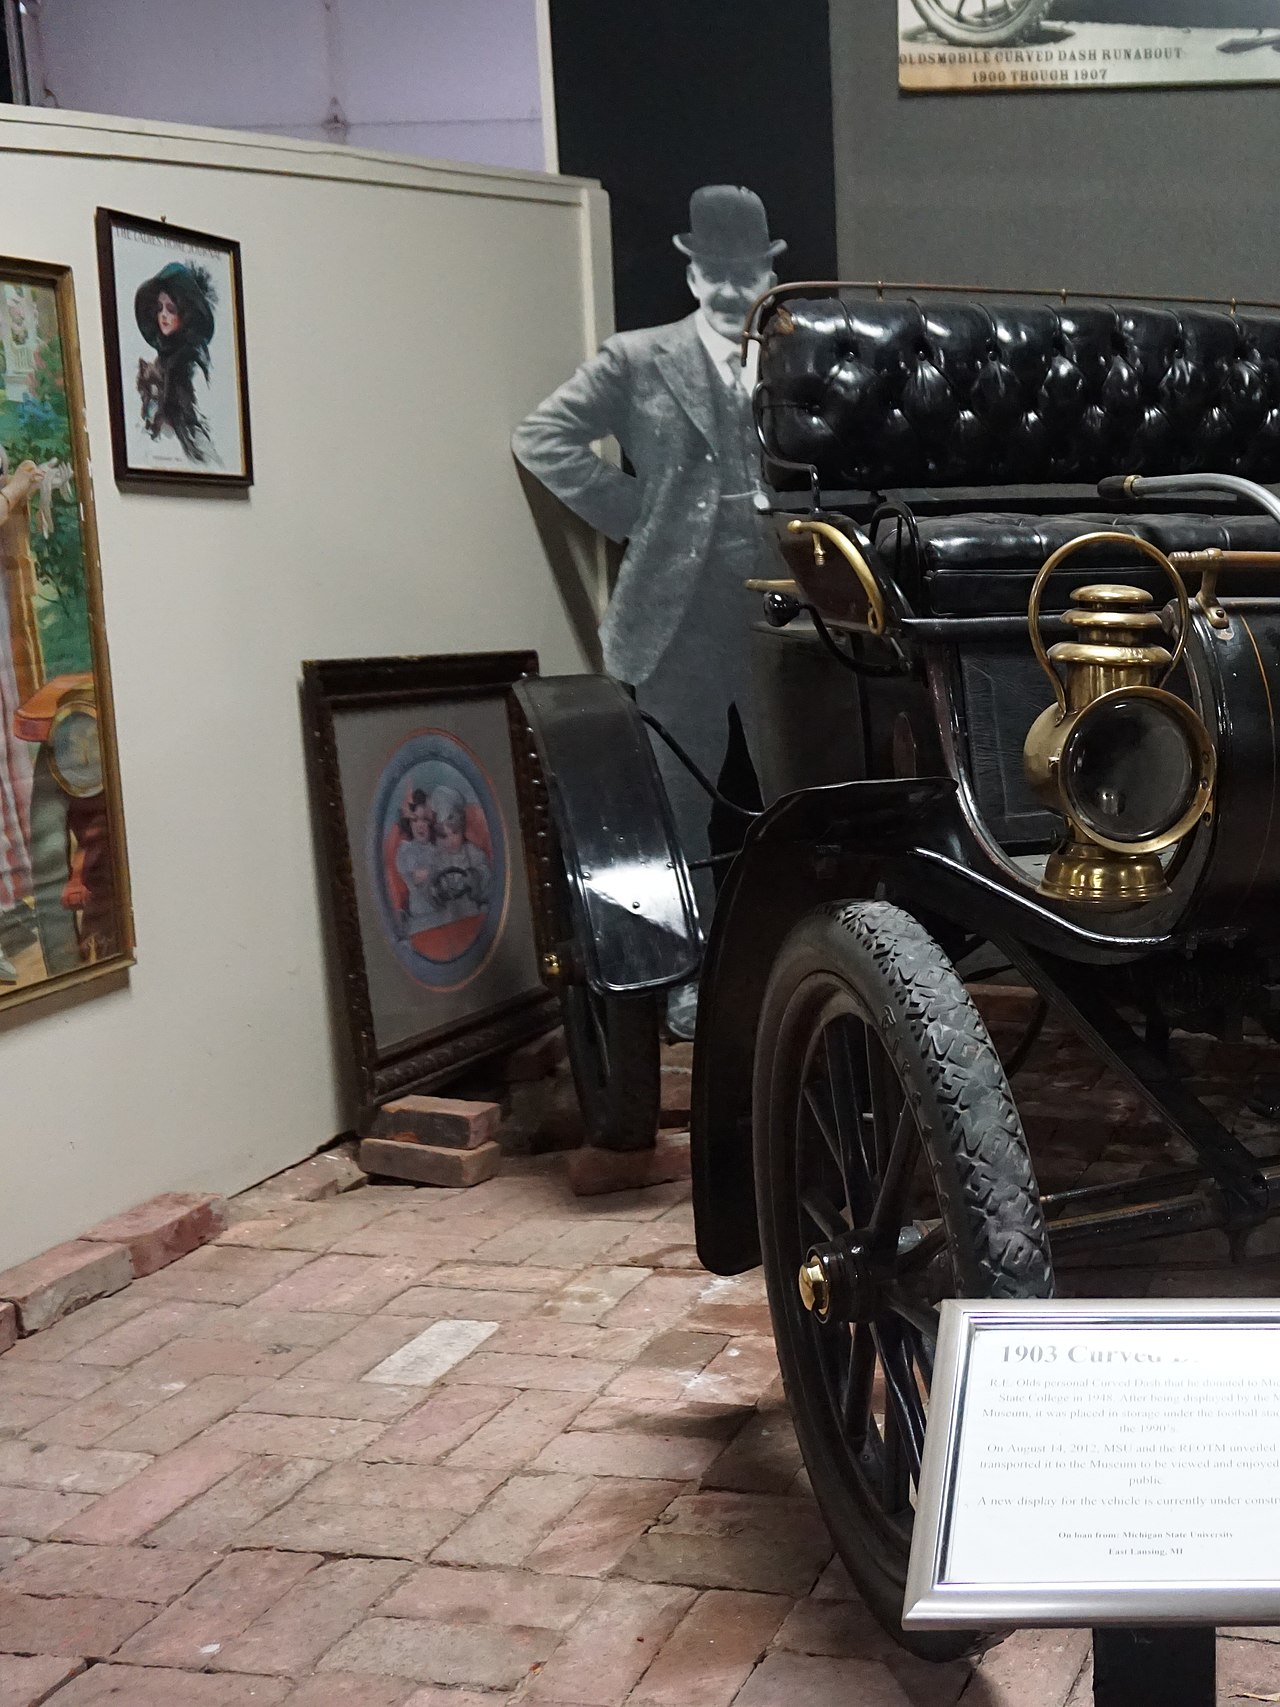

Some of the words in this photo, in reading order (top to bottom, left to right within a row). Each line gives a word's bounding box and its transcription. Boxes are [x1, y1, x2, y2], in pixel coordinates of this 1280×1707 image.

[899, 51, 991, 65] OLDSMOBILE
[994, 49, 1054, 63] CURVED
[1058, 49, 1097, 61] DASH
[1101, 47, 1183, 60] RUNABOUT
[972, 71, 1007, 82] 1900
[1010, 69, 1069, 82] THOUGH
[1074, 69, 1107, 81] 1907
[1001, 1344, 1058, 1364] 1903
[1016, 1378, 1040, 1387] Olds
[1044, 1378, 1089, 1389] personal
[1092, 1378, 1130, 1387] Curved
[1134, 1378, 1161, 1387] Dash
[1164, 1378, 1184, 1387] that
[1187, 1378, 1199, 1387] he
[1202, 1378, 1244, 1387] donated
[1247, 1379, 1258, 1387] to
[999, 1393, 1025, 1403] State
[1028, 1393, 1069, 1405] College
[1073, 1393, 1083, 1403] in
[1120, 1393, 1147, 1403] After
[1150, 1393, 1180, 1404] being
[1183, 1393, 1233, 1405] displayed
[1237, 1393, 1250, 1405] by
[1253, 1393, 1268, 1402] the
[1035, 1409, 1043, 1418] it
[1046, 1410, 1067, 1418] was
[1070, 1408, 1105, 1419] placed
[1108, 1409, 1119, 1418] in
[1121, 1409, 1160, 1419] storage
[1163, 1408, 1193, 1418] under
[1197, 1408, 1213, 1418] the
[1217, 1408, 1258, 1418] football
[1119, 1424, 1136, 1433] the
[986, 1443, 1004, 1453] On
[1007, 1443, 1046, 1456] August
[1103, 1443, 1133, 1453] MSU
[1136, 1443, 1156, 1453] and
[1159, 1443, 1175, 1453] the
[1229, 1443, 1276, 1453] unveiled
[980, 1460, 1041, 1471] transported
[1044, 1460, 1052, 1469] it
[1055, 1461, 1066, 1469] to
[1069, 1459, 1086, 1469] the
[1089, 1459, 1137, 1469] Museum
[1140, 1460, 1151, 1469] to
[1154, 1459, 1167, 1469] be
[1171, 1459, 1210, 1469] viewed
[1213, 1459, 1233, 1468] and
[1236, 1459, 1279, 1470] enjoyed
[977, 1496, 987, 1506] A
[990, 1498, 1014, 1506] new
[1017, 1496, 1057, 1508] display
[1061, 1496, 1076, 1506] for
[1080, 1496, 1097, 1506] the
[1100, 1496, 1141, 1506] vehicle
[1144, 1496, 1153, 1506] is
[1156, 1496, 1206, 1508] currently
[1210, 1496, 1241, 1505] under
[1058, 1531, 1072, 1539] On
[1074, 1531, 1093, 1539] loan
[1122, 1531, 1163, 1540] Michigan
[1190, 1531, 1233, 1540] University
[1171, 1547, 1184, 1555] MI
